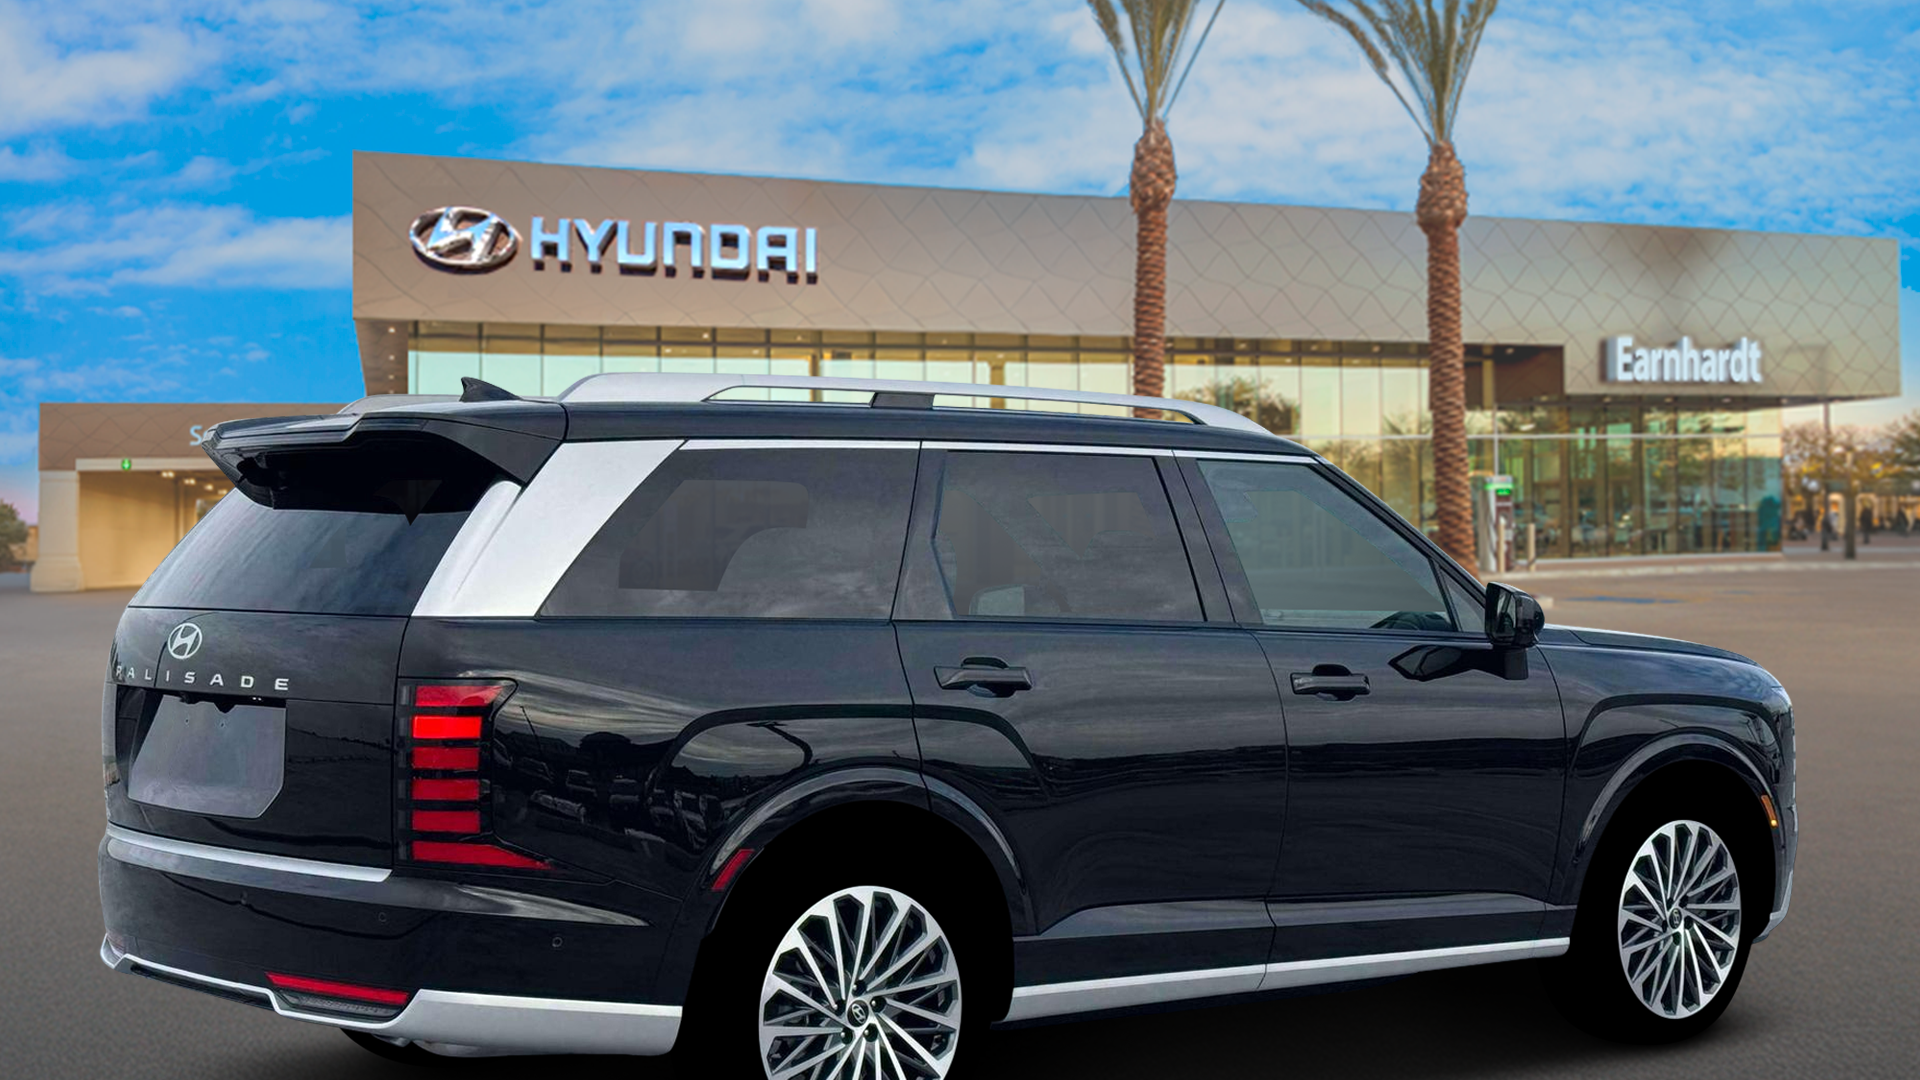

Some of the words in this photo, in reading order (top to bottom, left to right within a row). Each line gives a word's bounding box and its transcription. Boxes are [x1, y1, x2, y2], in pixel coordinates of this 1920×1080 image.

[530, 216, 819, 276] HYUNDAI
[1615, 335, 1763, 383] Earnhardt
[115, 664, 290, 692] PALISADE
